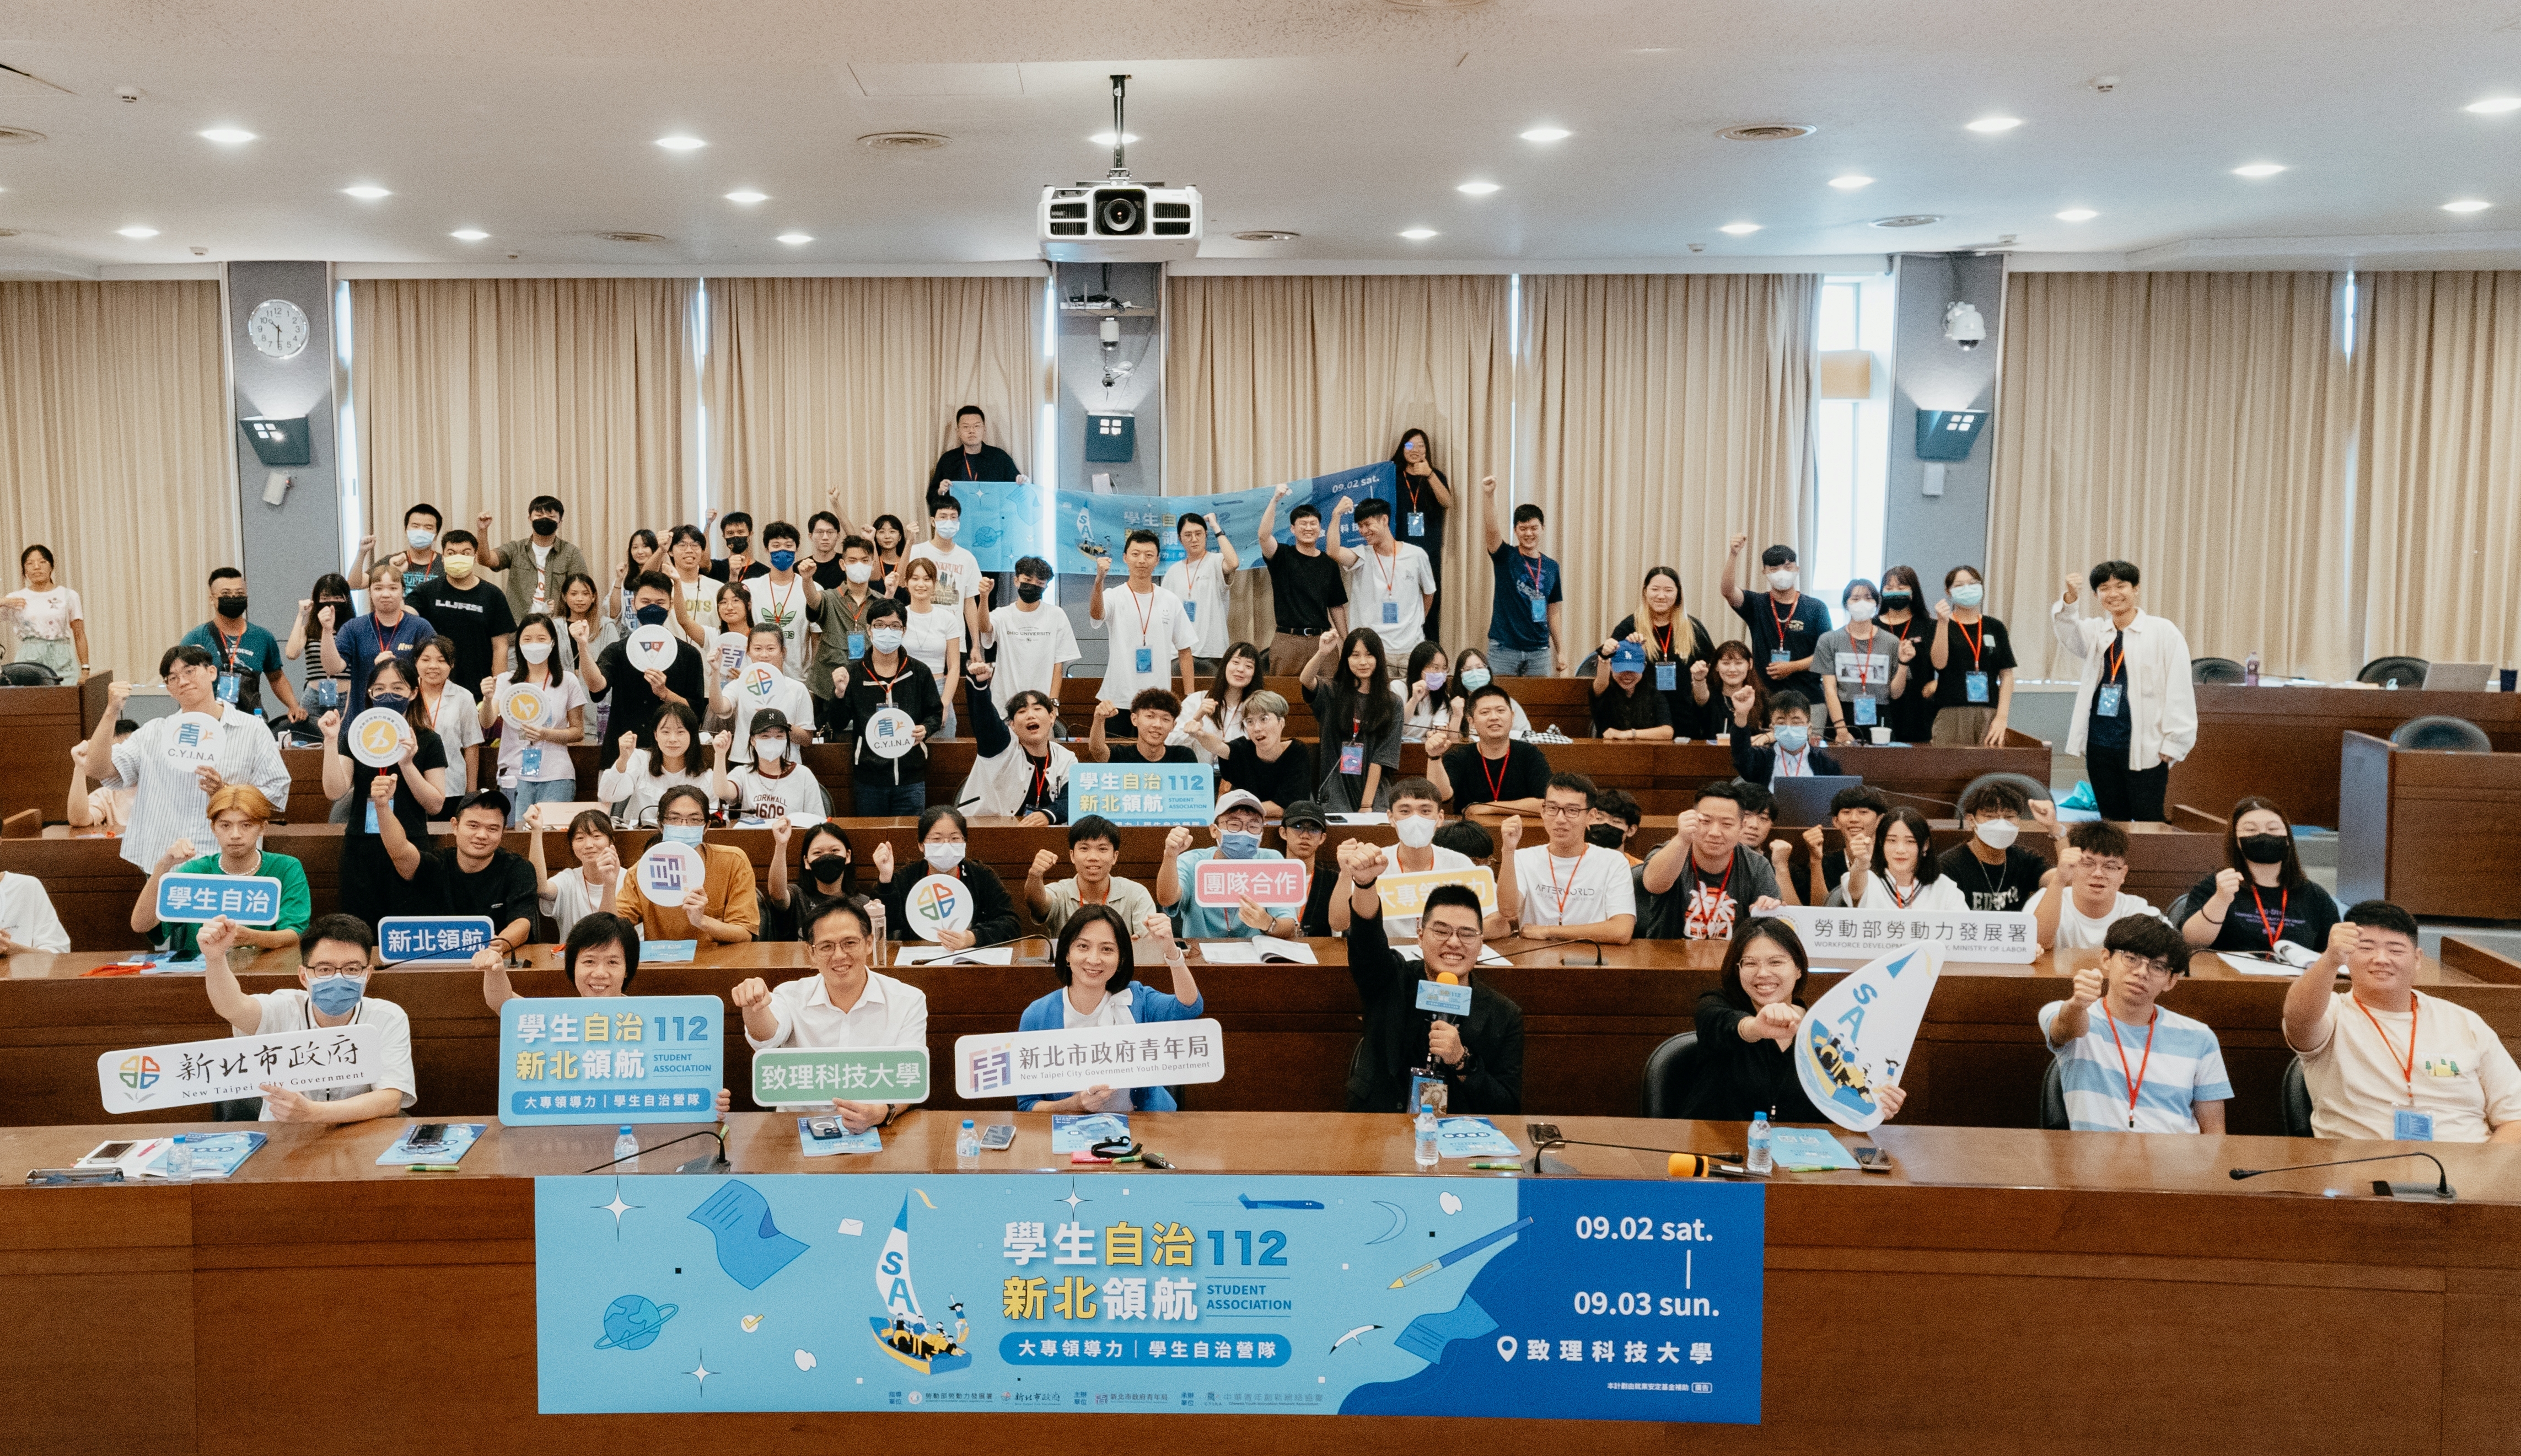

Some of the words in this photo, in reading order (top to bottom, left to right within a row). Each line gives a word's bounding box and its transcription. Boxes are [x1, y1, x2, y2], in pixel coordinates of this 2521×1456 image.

[1332, 480, 1359, 493] 09.02
[1361, 475, 1379, 486] sat.
[1124, 511, 1180, 527] 學生自
[935, 561, 964, 574] NKFURT
[168, 748, 214, 761] C.Y.I.N.A
[874, 738, 910, 749] C.Y.I.N.A
[1079, 772, 1162, 791] 學生自治
[1168, 775, 1204, 790] 112
[1079, 794, 1163, 812] 新北領航
[1203, 872, 1298, 896] 團隊合作
[1535, 884, 1595, 896] AFTERORLD
[166, 885, 271, 914] 學生自治
[388, 927, 486, 954] 新北領航
[1815, 918, 2028, 943] 勞動部勞動力發展署
[1837, 983, 1878, 1045] SA
[517, 1012, 644, 1044] 學生自治
[654, 1016, 708, 1042] 112
[176, 1034, 358, 1083] 新北市政府
[1019, 1035, 1209, 1070] 新北市政府青年局
[516, 1049, 644, 1081] 新北領航
[653, 1064, 712, 1073] ASSOCIATION
[761, 1062, 921, 1090] 致理科技大學
[1040, 1071, 1063, 1079] Taipei
[1085, 1067, 1134, 1076] Government
[1162, 1061, 1210, 1072] Department
[182, 1089, 208, 1098] New
[214, 1083, 254, 1094] Taipei
[291, 1071, 365, 1086] Government
[525, 1095, 596, 1110] 大專領導力
[614, 1093, 701, 1108] 學生自治營隊
[1576, 1216, 1654, 1240] 09.02
[1662, 1218, 1713, 1241] sat.
[1003, 1221, 1196, 1266] 學生自治
[1207, 1229, 1288, 1266] 112
[880, 1251, 915, 1313] SA
[1207, 1284, 1267, 1296] STUDENT
[1002, 1276, 1197, 1321] 新北領航
[1207, 1299, 1292, 1310] ASSOCIATION
[1574, 1292, 1651, 1315] 09.03
[1659, 1296, 1719, 1317] sun.
[1018, 1340, 1124, 1359] 大專領導力
[1149, 1340, 1277, 1359] 學生自治營隊
[1526, 1339, 1712, 1364] 致理科技大學
[1015, 1391, 1060, 1401] 新北市政府
